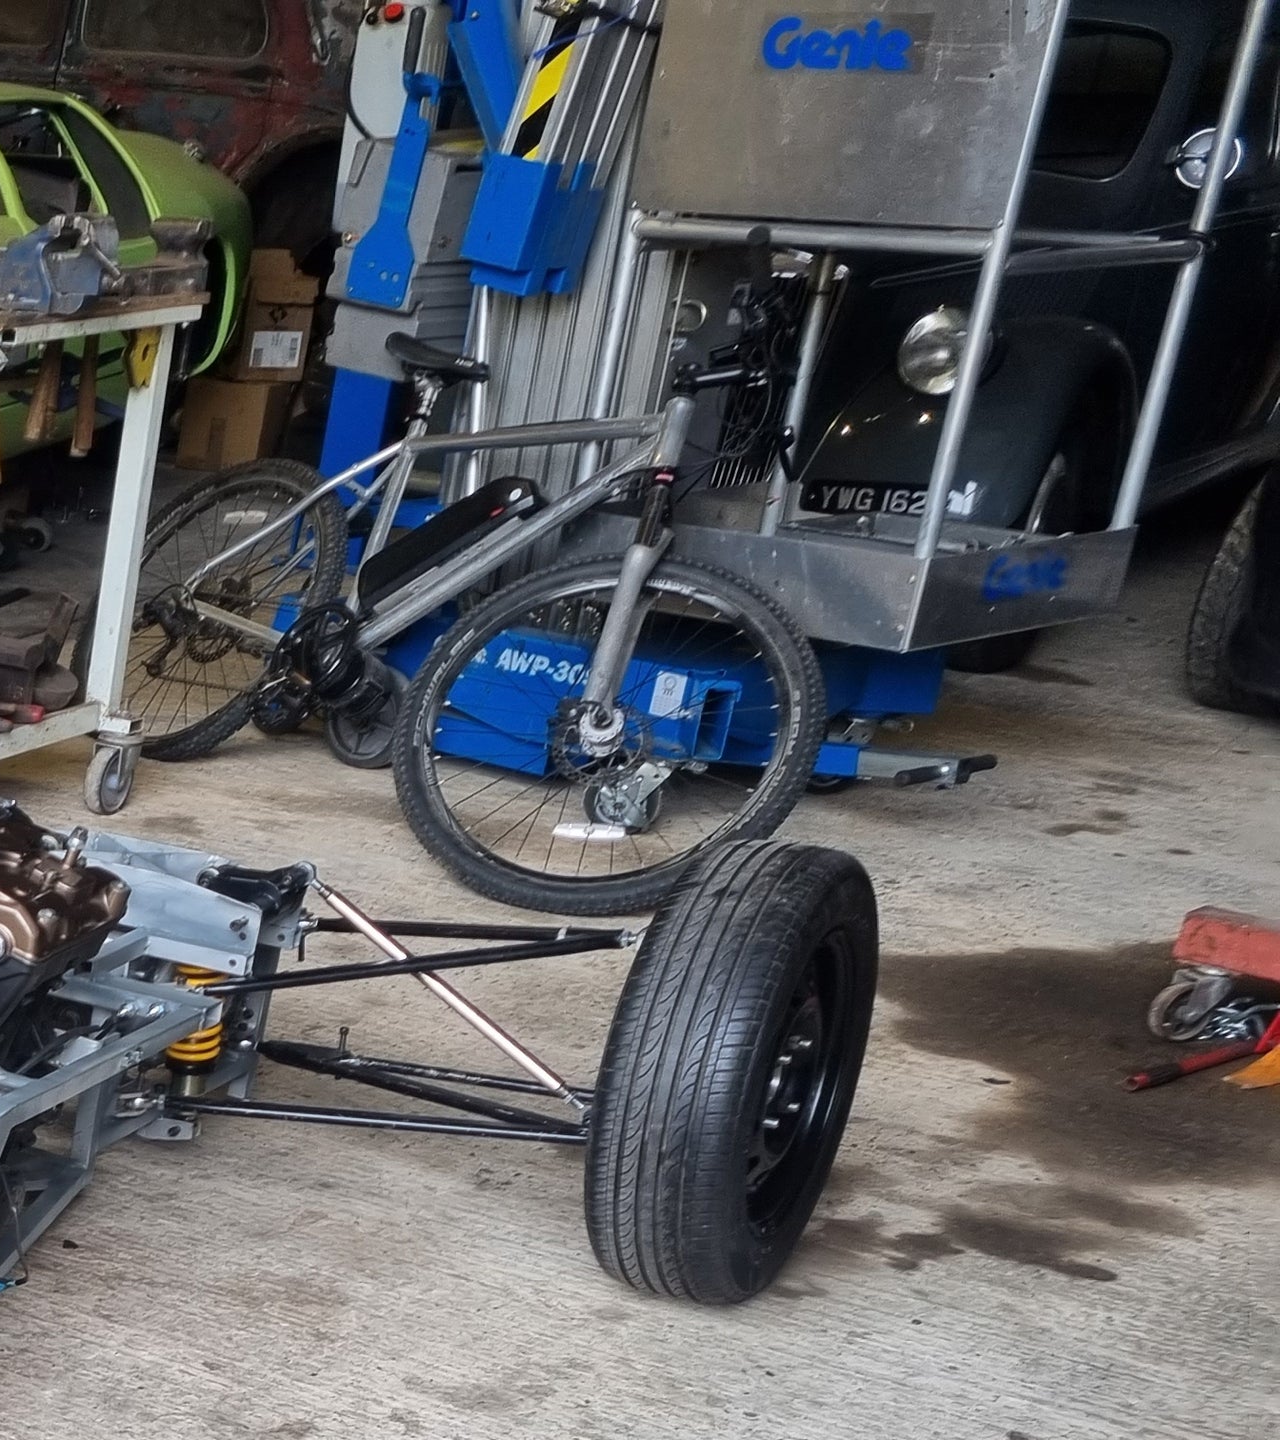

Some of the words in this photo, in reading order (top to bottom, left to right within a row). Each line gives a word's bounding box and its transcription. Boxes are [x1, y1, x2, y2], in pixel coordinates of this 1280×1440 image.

[761, 16, 912, 72] Genie
[821, 485, 876, 511] YWG
[880, 489, 929, 514] 162
[494, 648, 593, 686] AWP-30
